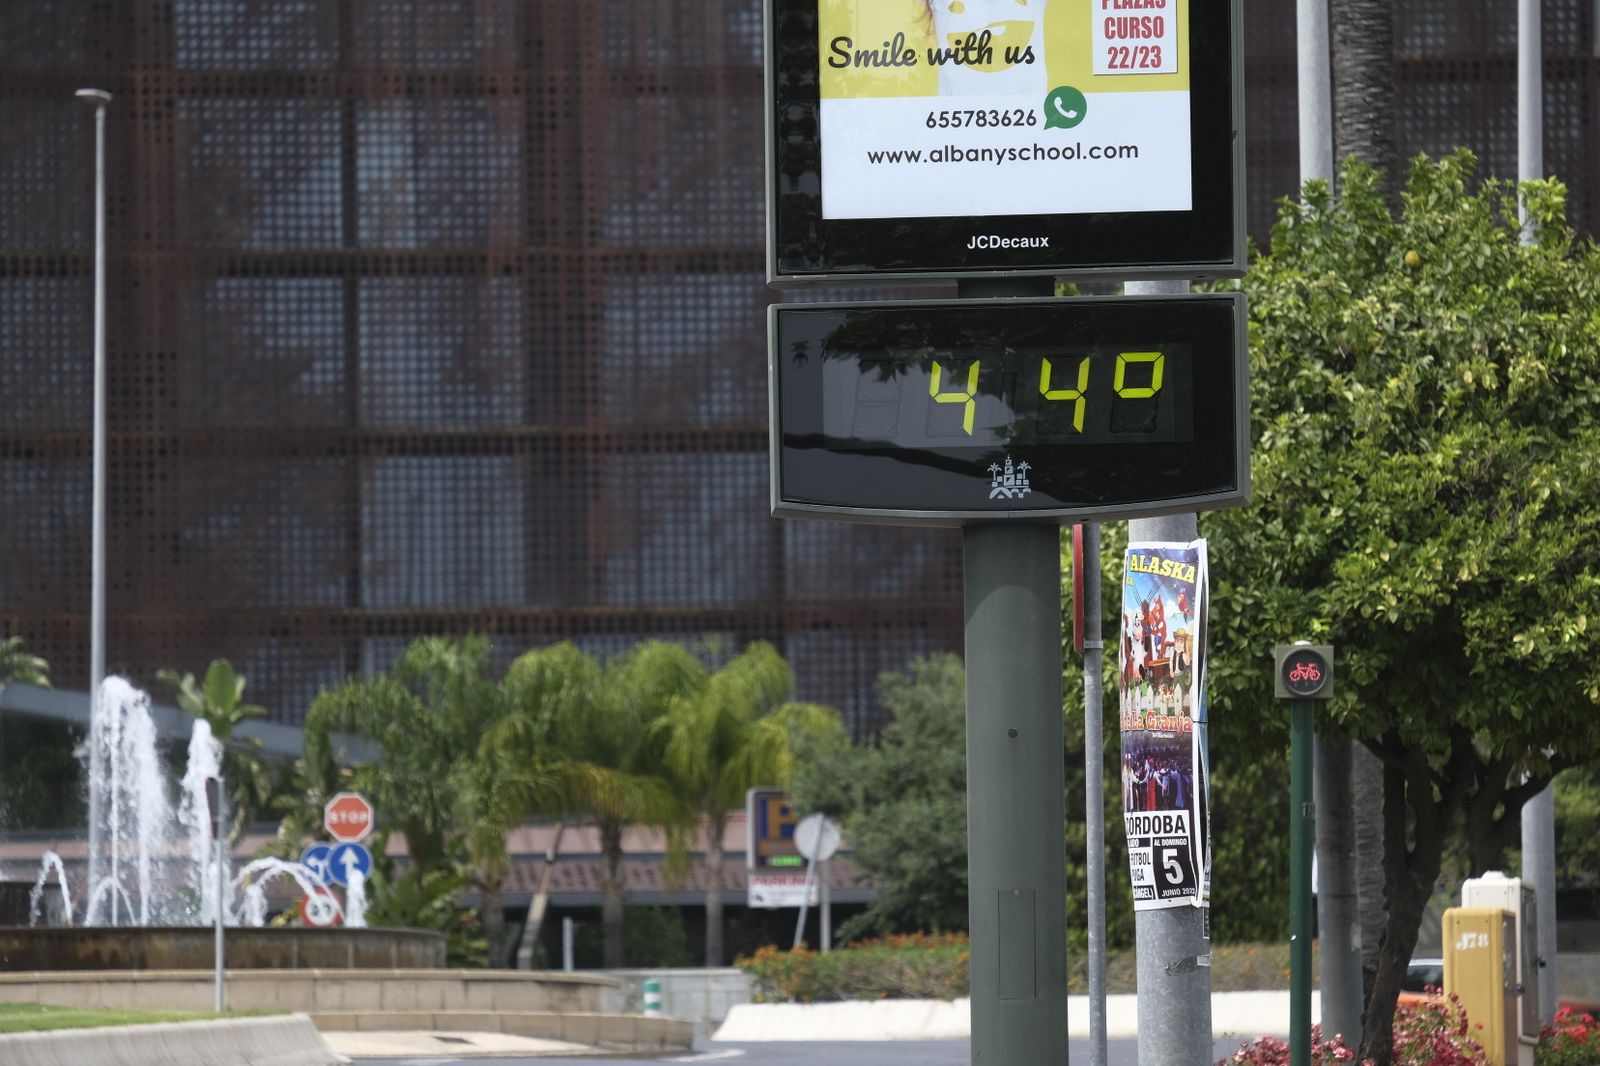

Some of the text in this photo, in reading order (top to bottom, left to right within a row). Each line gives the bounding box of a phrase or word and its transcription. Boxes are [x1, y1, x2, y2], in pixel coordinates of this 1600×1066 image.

[1104, 16, 1164, 39] CURSO
[828, 30, 1036, 68] Smile with us
[1107, 45, 1162, 69] 22/23
[926, 109, 1037, 128] 655783626
[867, 142, 1139, 165] www.albanyschool.com
[967, 234, 1049, 250] JCDecaux
[1130, 554, 1195, 583] ALASKA
[1146, 710, 1192, 736] Granja
[328, 810, 369, 825] STOP
[1162, 838, 1187, 847] DOMINGO
[1163, 849, 1184, 884] 5
[1162, 888, 1181, 897] JUNIO
